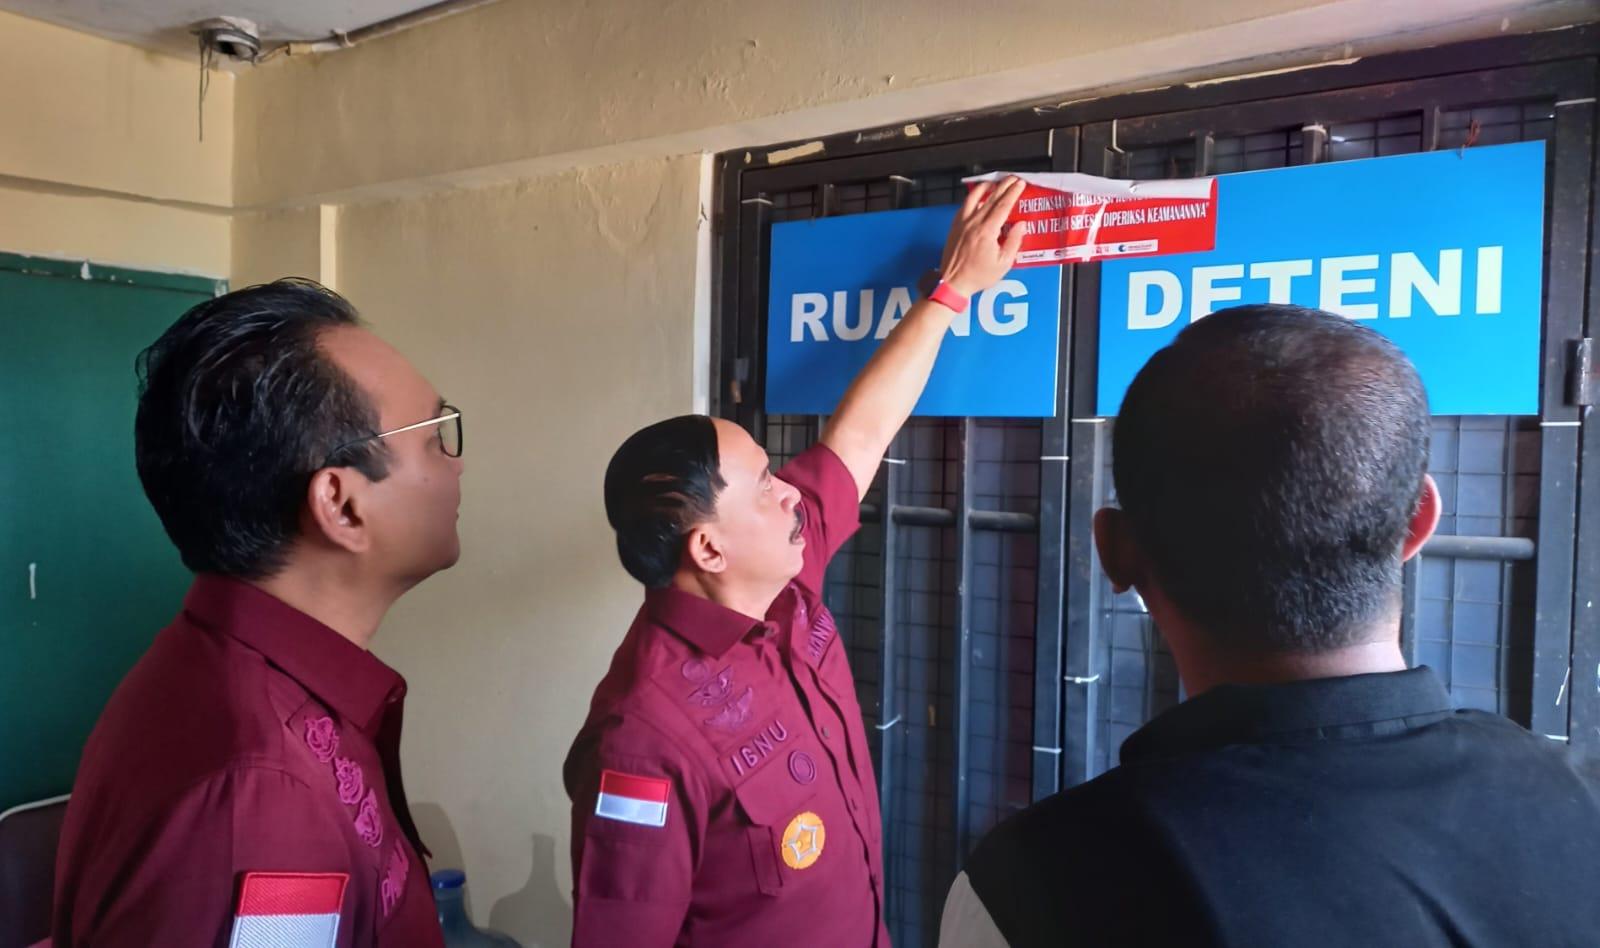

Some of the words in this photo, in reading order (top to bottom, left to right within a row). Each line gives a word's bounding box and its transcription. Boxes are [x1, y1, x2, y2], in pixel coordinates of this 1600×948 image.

[1103, 208, 1146, 227] DIPERIKSA
[1127, 245, 1503, 330] DETENI
[730, 719, 788, 777] IBNU
